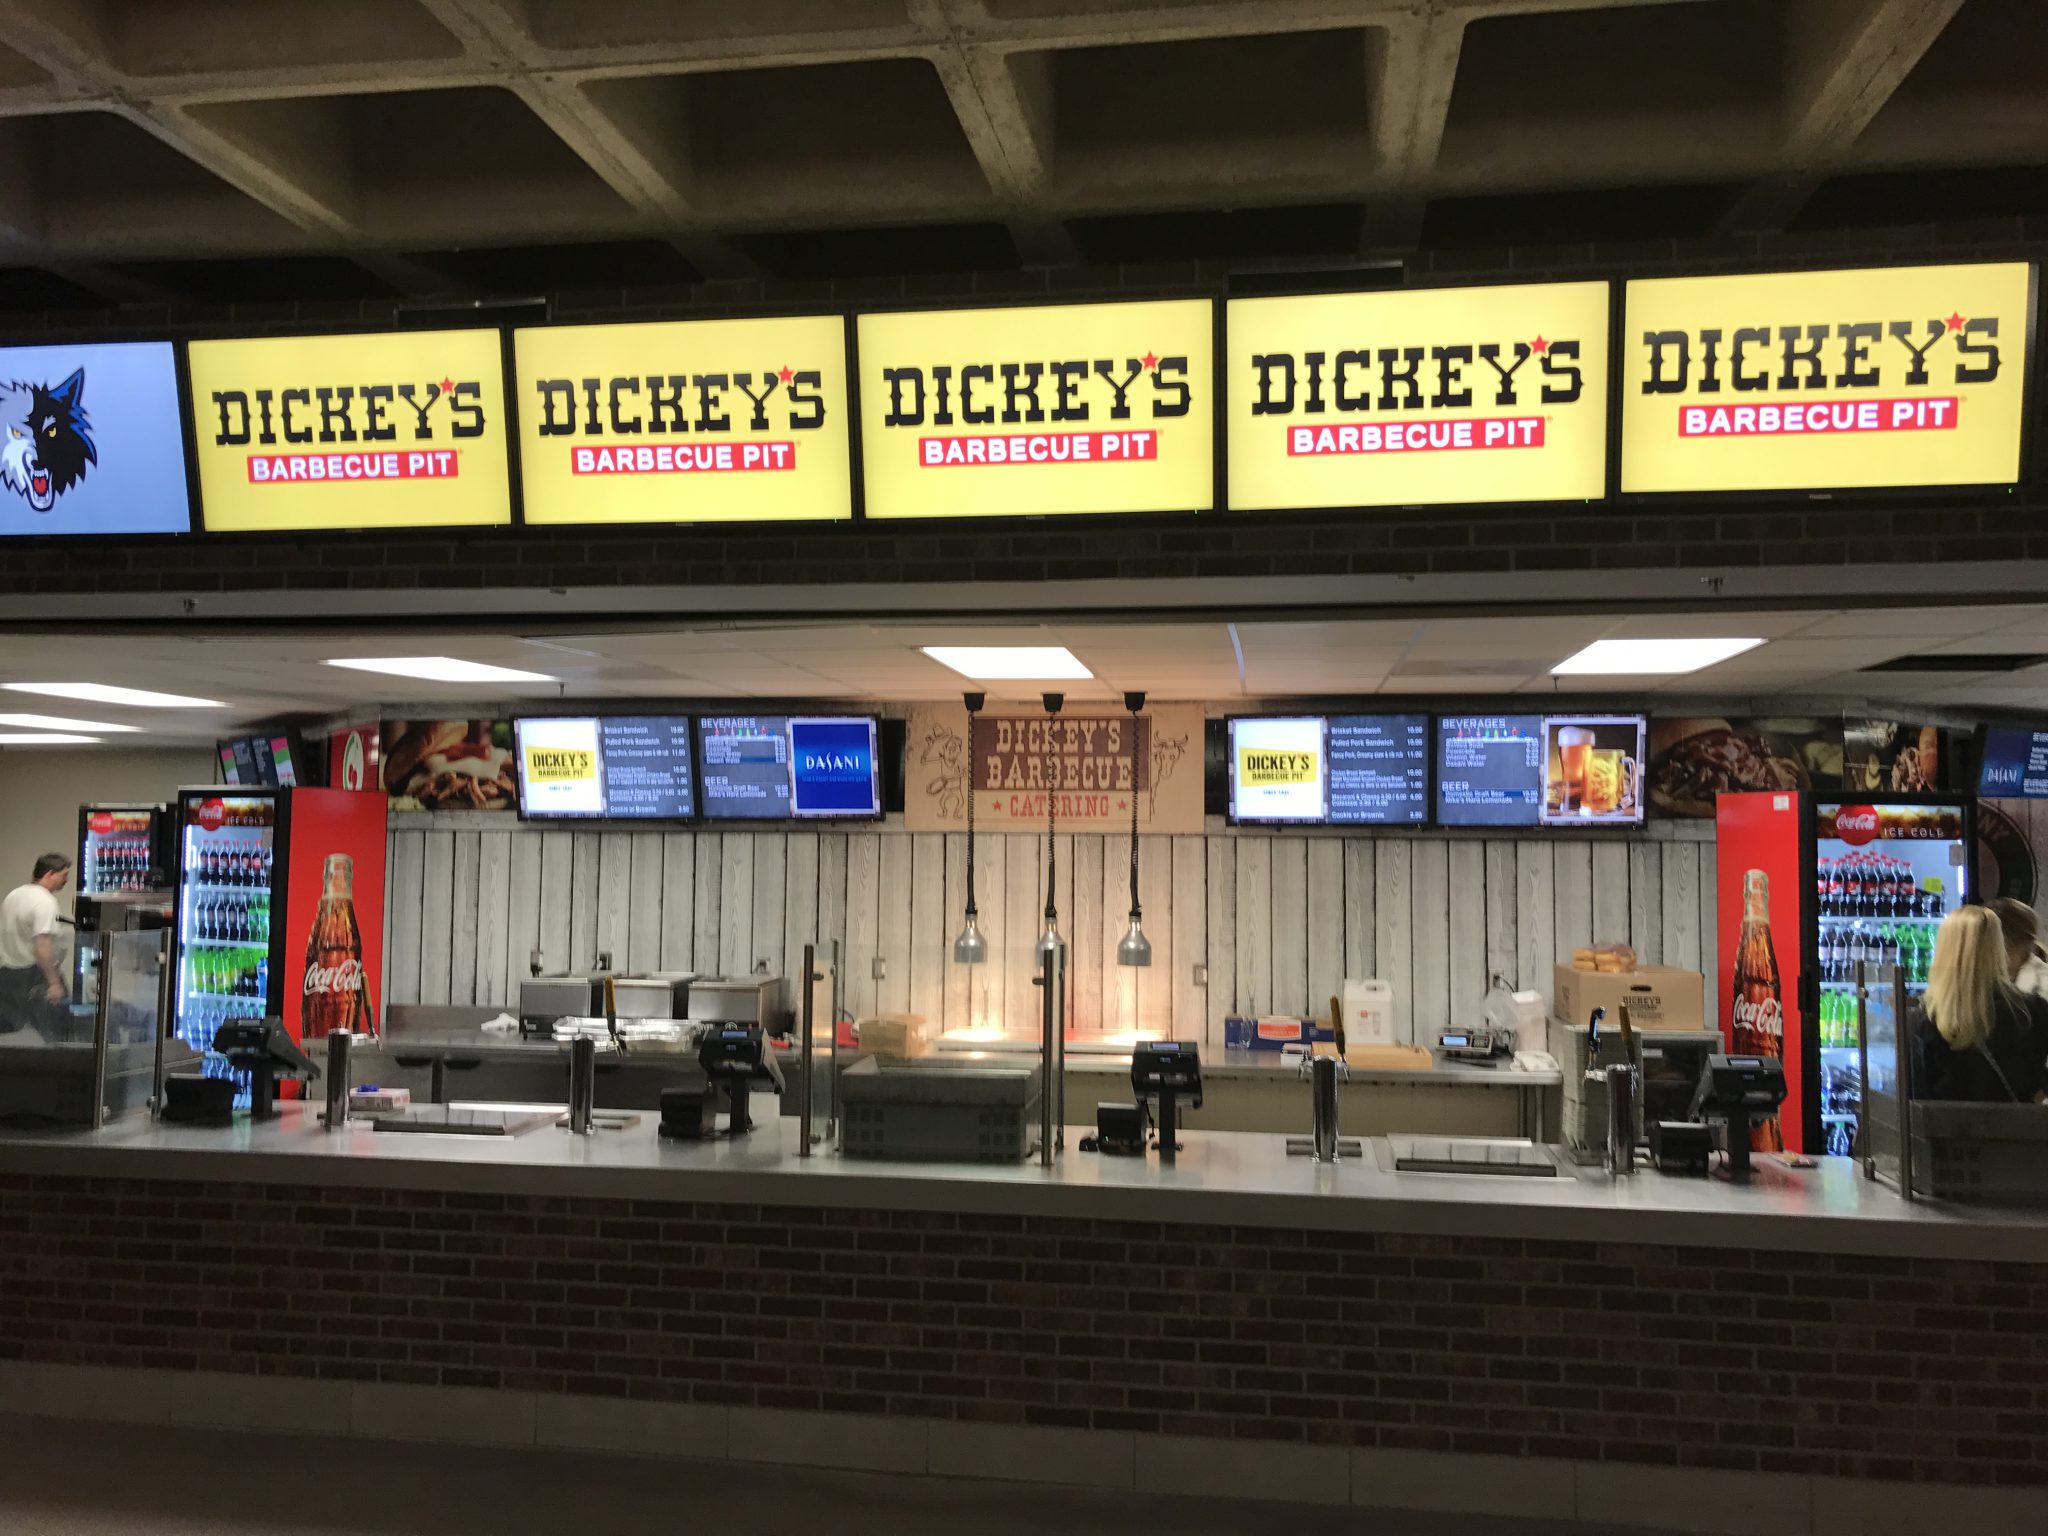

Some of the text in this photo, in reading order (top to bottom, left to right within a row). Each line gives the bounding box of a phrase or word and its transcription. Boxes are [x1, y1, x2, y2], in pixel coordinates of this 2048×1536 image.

[1686, 401, 1951, 434] BARBECUE PIT
[925, 434, 1150, 464] BARBECUE PIT
[1293, 420, 1538, 453] BARBECUE PIT
[252, 452, 451, 480] BARBECUE PIT
[577, 444, 788, 472] BARBECUE PIT
[701, 718, 755, 728] BEVERAGES
[1443, 718, 1505, 729] BEVERAGES
[997, 720, 1120, 753] DICKEY'S
[806, 752, 859, 773] DASANI
[987, 755, 1131, 789] BARBECUE
[705, 776, 728, 786] BEER
[1442, 781, 1469, 791] BEER
[1010, 795, 1109, 817] CATERING
[1884, 827, 1944, 838] ICE COLD
